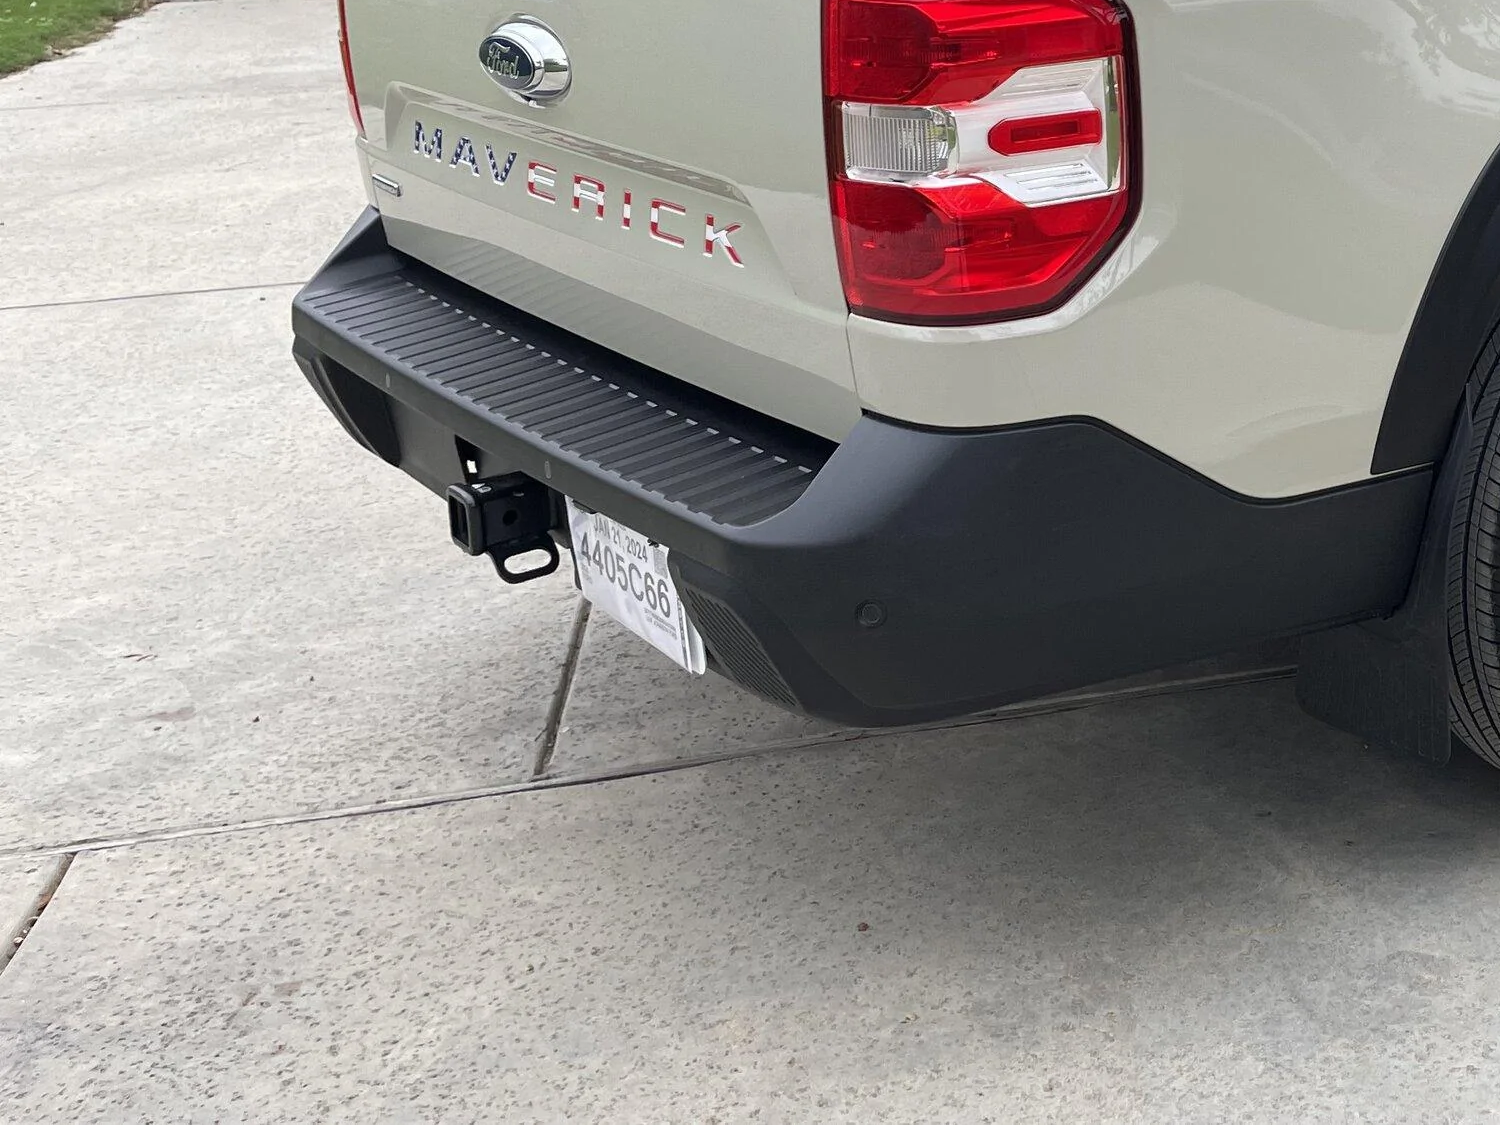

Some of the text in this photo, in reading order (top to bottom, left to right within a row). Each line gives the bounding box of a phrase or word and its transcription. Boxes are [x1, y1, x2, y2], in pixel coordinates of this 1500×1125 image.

[486, 41, 520, 80] Ford
[413, 120, 744, 268] MAVERICK
[593, 515, 611, 539] JAN
[625, 536, 648, 563] 2024
[581, 532, 671, 618] 4405C66
